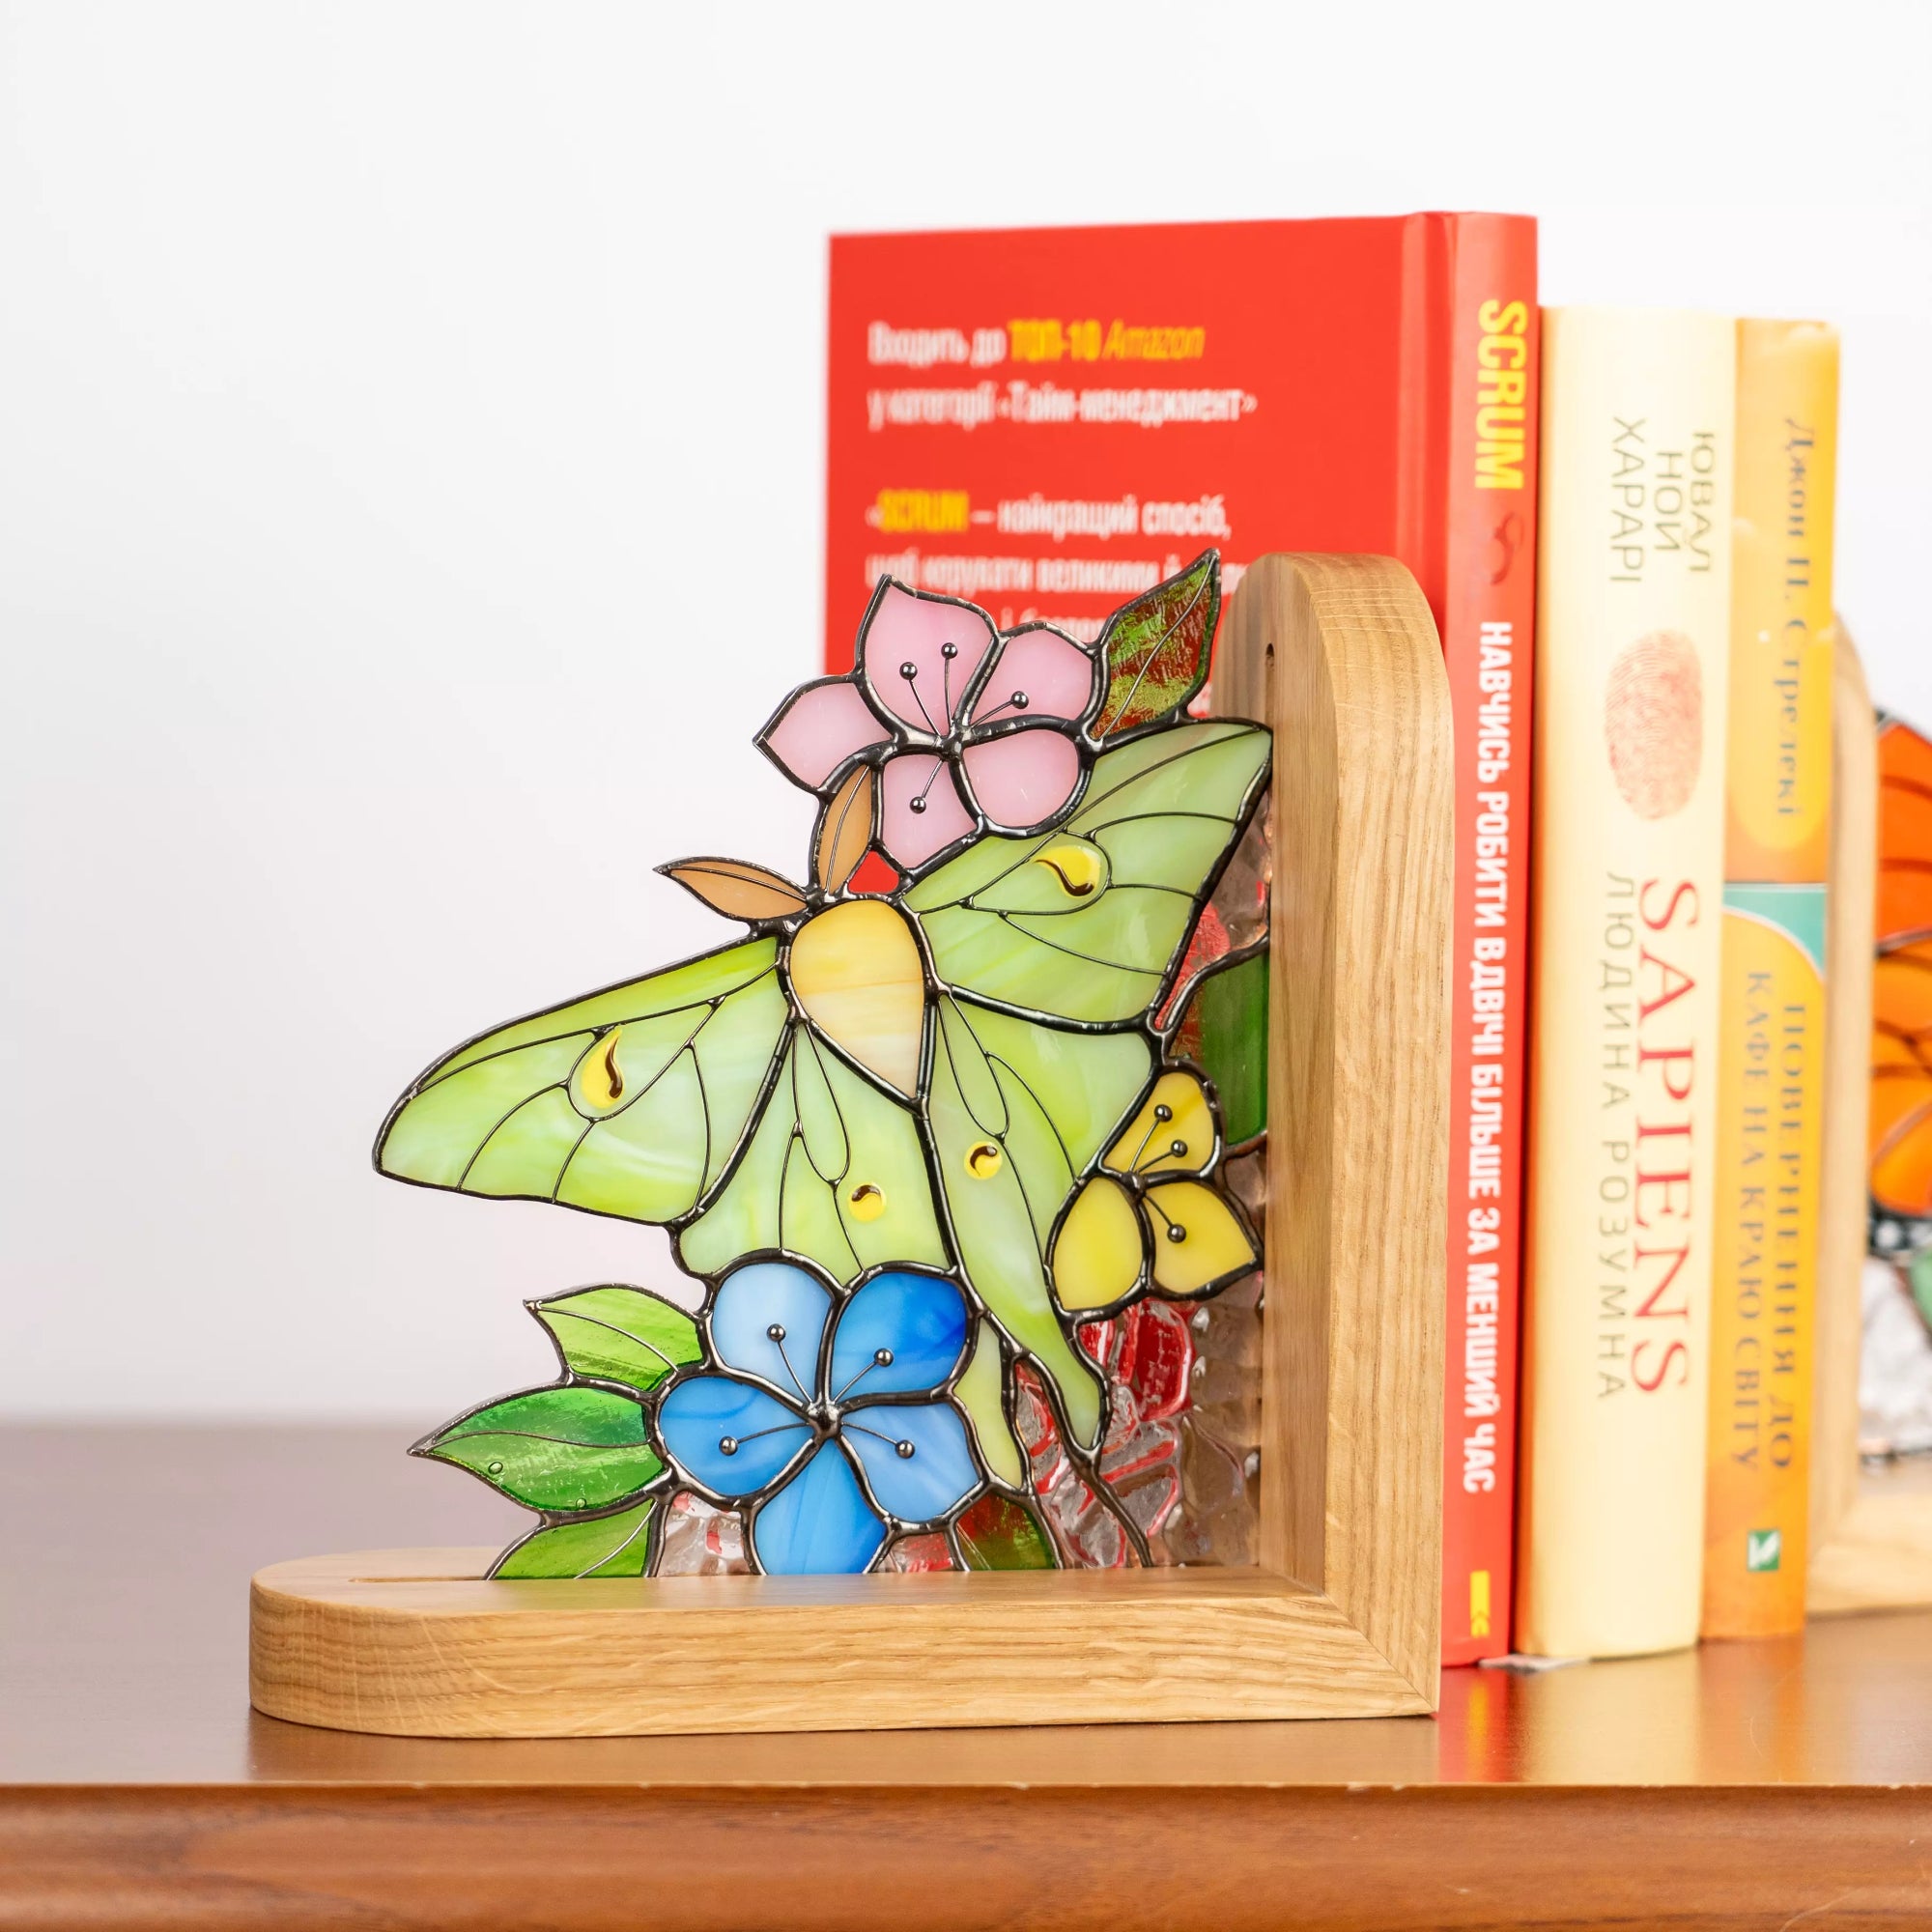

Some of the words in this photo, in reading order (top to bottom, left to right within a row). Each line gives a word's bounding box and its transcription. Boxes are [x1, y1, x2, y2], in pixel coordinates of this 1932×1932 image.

[970, 327, 1007, 366] до
[1008, 319, 1101, 361] ТОП-10
[1102, 320, 1206, 360] Amazon
[1474, 299, 1528, 489] SCRUM
[1609, 416, 1646, 582] ХАРАРІ
[1654, 451, 1689, 552] НОЙ
[1689, 431, 1715, 573] ЮВАЛ
[1785, 417, 1814, 537] Джон
[1478, 621, 1512, 783] НАВЧИСЬ
[1474, 791, 1509, 927] РОБИТИ
[1468, 937, 1506, 1056] ВДВІЧІ
[1599, 871, 1634, 1110] ЛЮДИНА
[1745, 971, 1772, 1084] КАФЕ
[1468, 1064, 1503, 1200] БІЛЬШЕ
[1633, 877, 1698, 1393] SAPIENS
[1741, 1107, 1768, 1165] НА
[1773, 1005, 1805, 1373] ПОВЕРНЕННЯ
[1466, 1208, 1499, 1255] ЗА
[1597, 1140, 1633, 1399] РОЗУМНА
[1738, 1187, 1765, 1320] КРАЮ
[1463, 1263, 1500, 1418] МЕНШИЙ
[1732, 1337, 1761, 1472] СВІТУ
[1463, 1423, 1495, 1492] ЧАС
[1769, 1393, 1794, 1467] ДО
